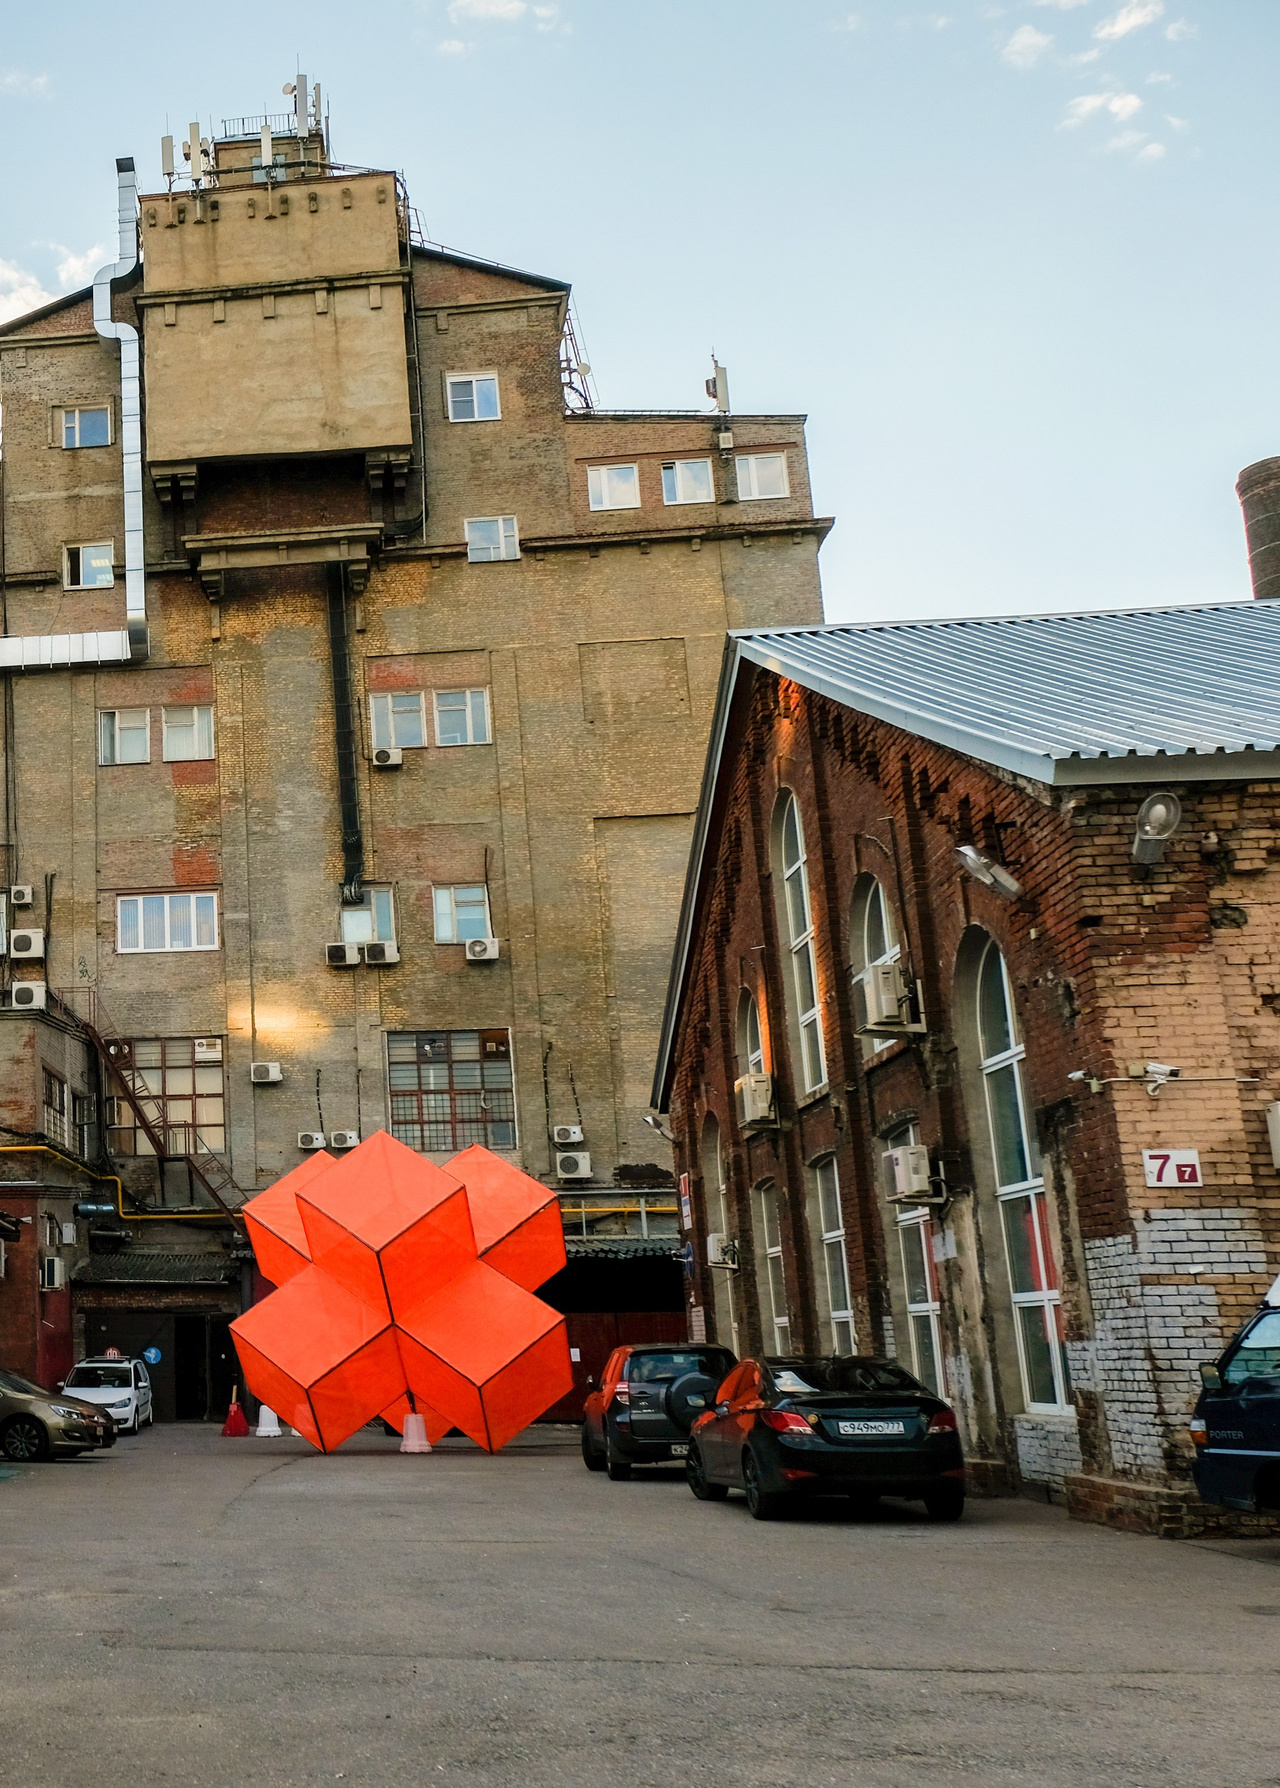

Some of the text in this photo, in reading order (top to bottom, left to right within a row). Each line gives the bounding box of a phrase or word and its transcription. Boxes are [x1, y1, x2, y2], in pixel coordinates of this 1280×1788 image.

[1148, 1154, 1192, 1182] 7 7
[1209, 1430, 1245, 1440] PORTER
